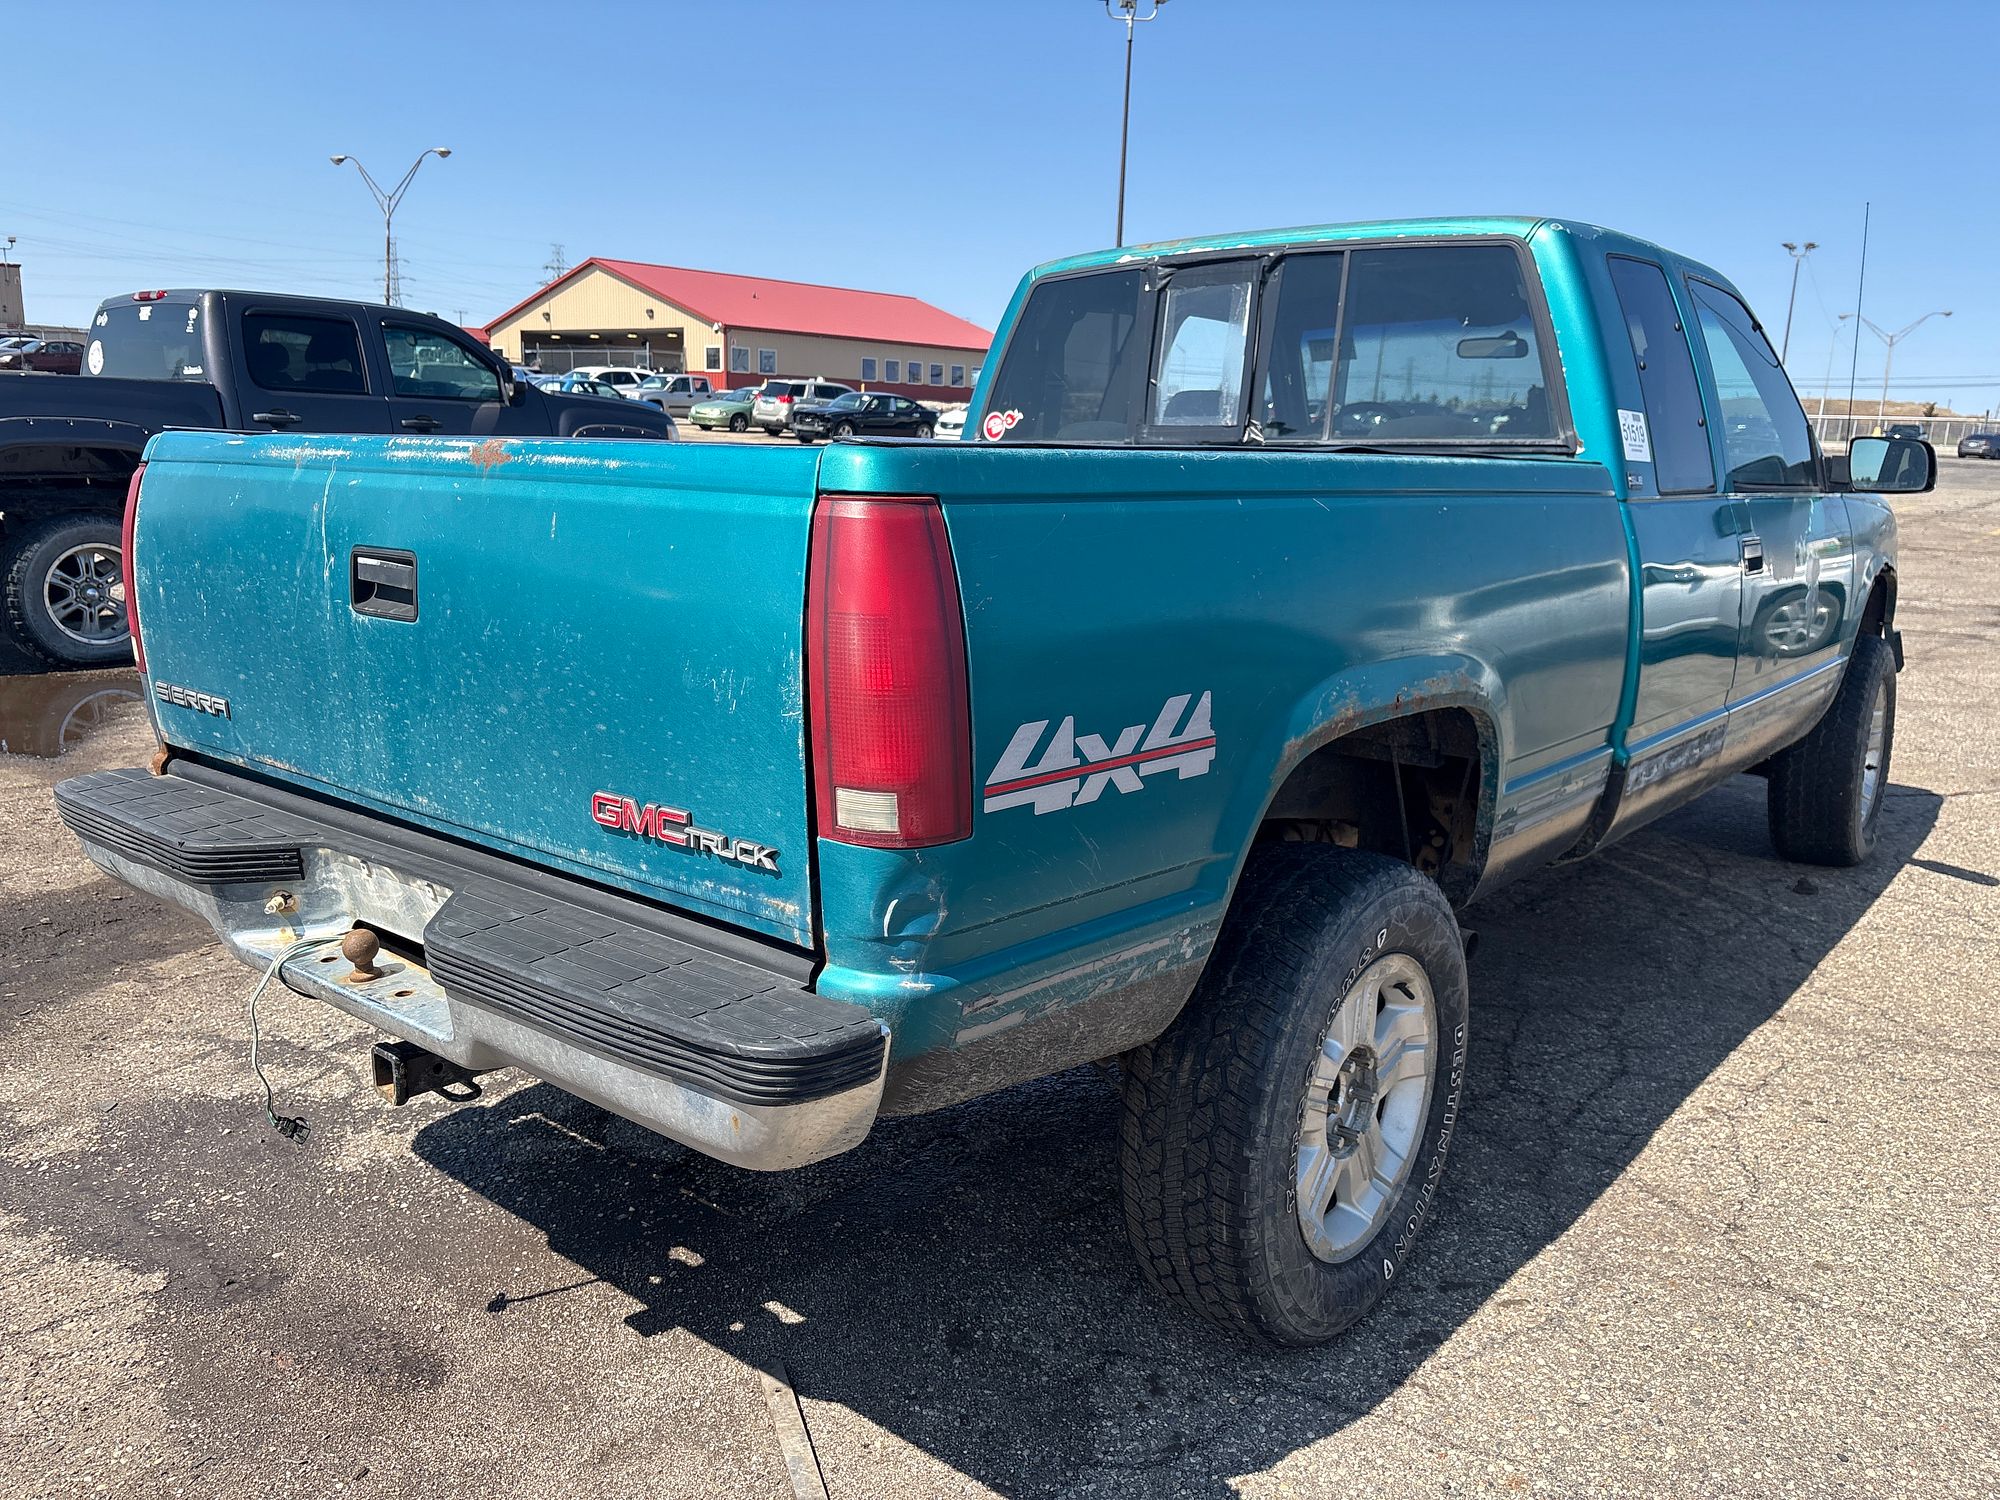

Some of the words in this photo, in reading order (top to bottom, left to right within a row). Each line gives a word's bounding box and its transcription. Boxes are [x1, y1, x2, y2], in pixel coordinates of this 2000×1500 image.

[1622, 423, 1645, 443] 51519
[155, 681, 231, 720] SIERRA
[592, 791, 692, 846] GMC
[684, 827, 780, 871] TRUCK
[1394, 1023, 1465, 1261] DESTINATION
